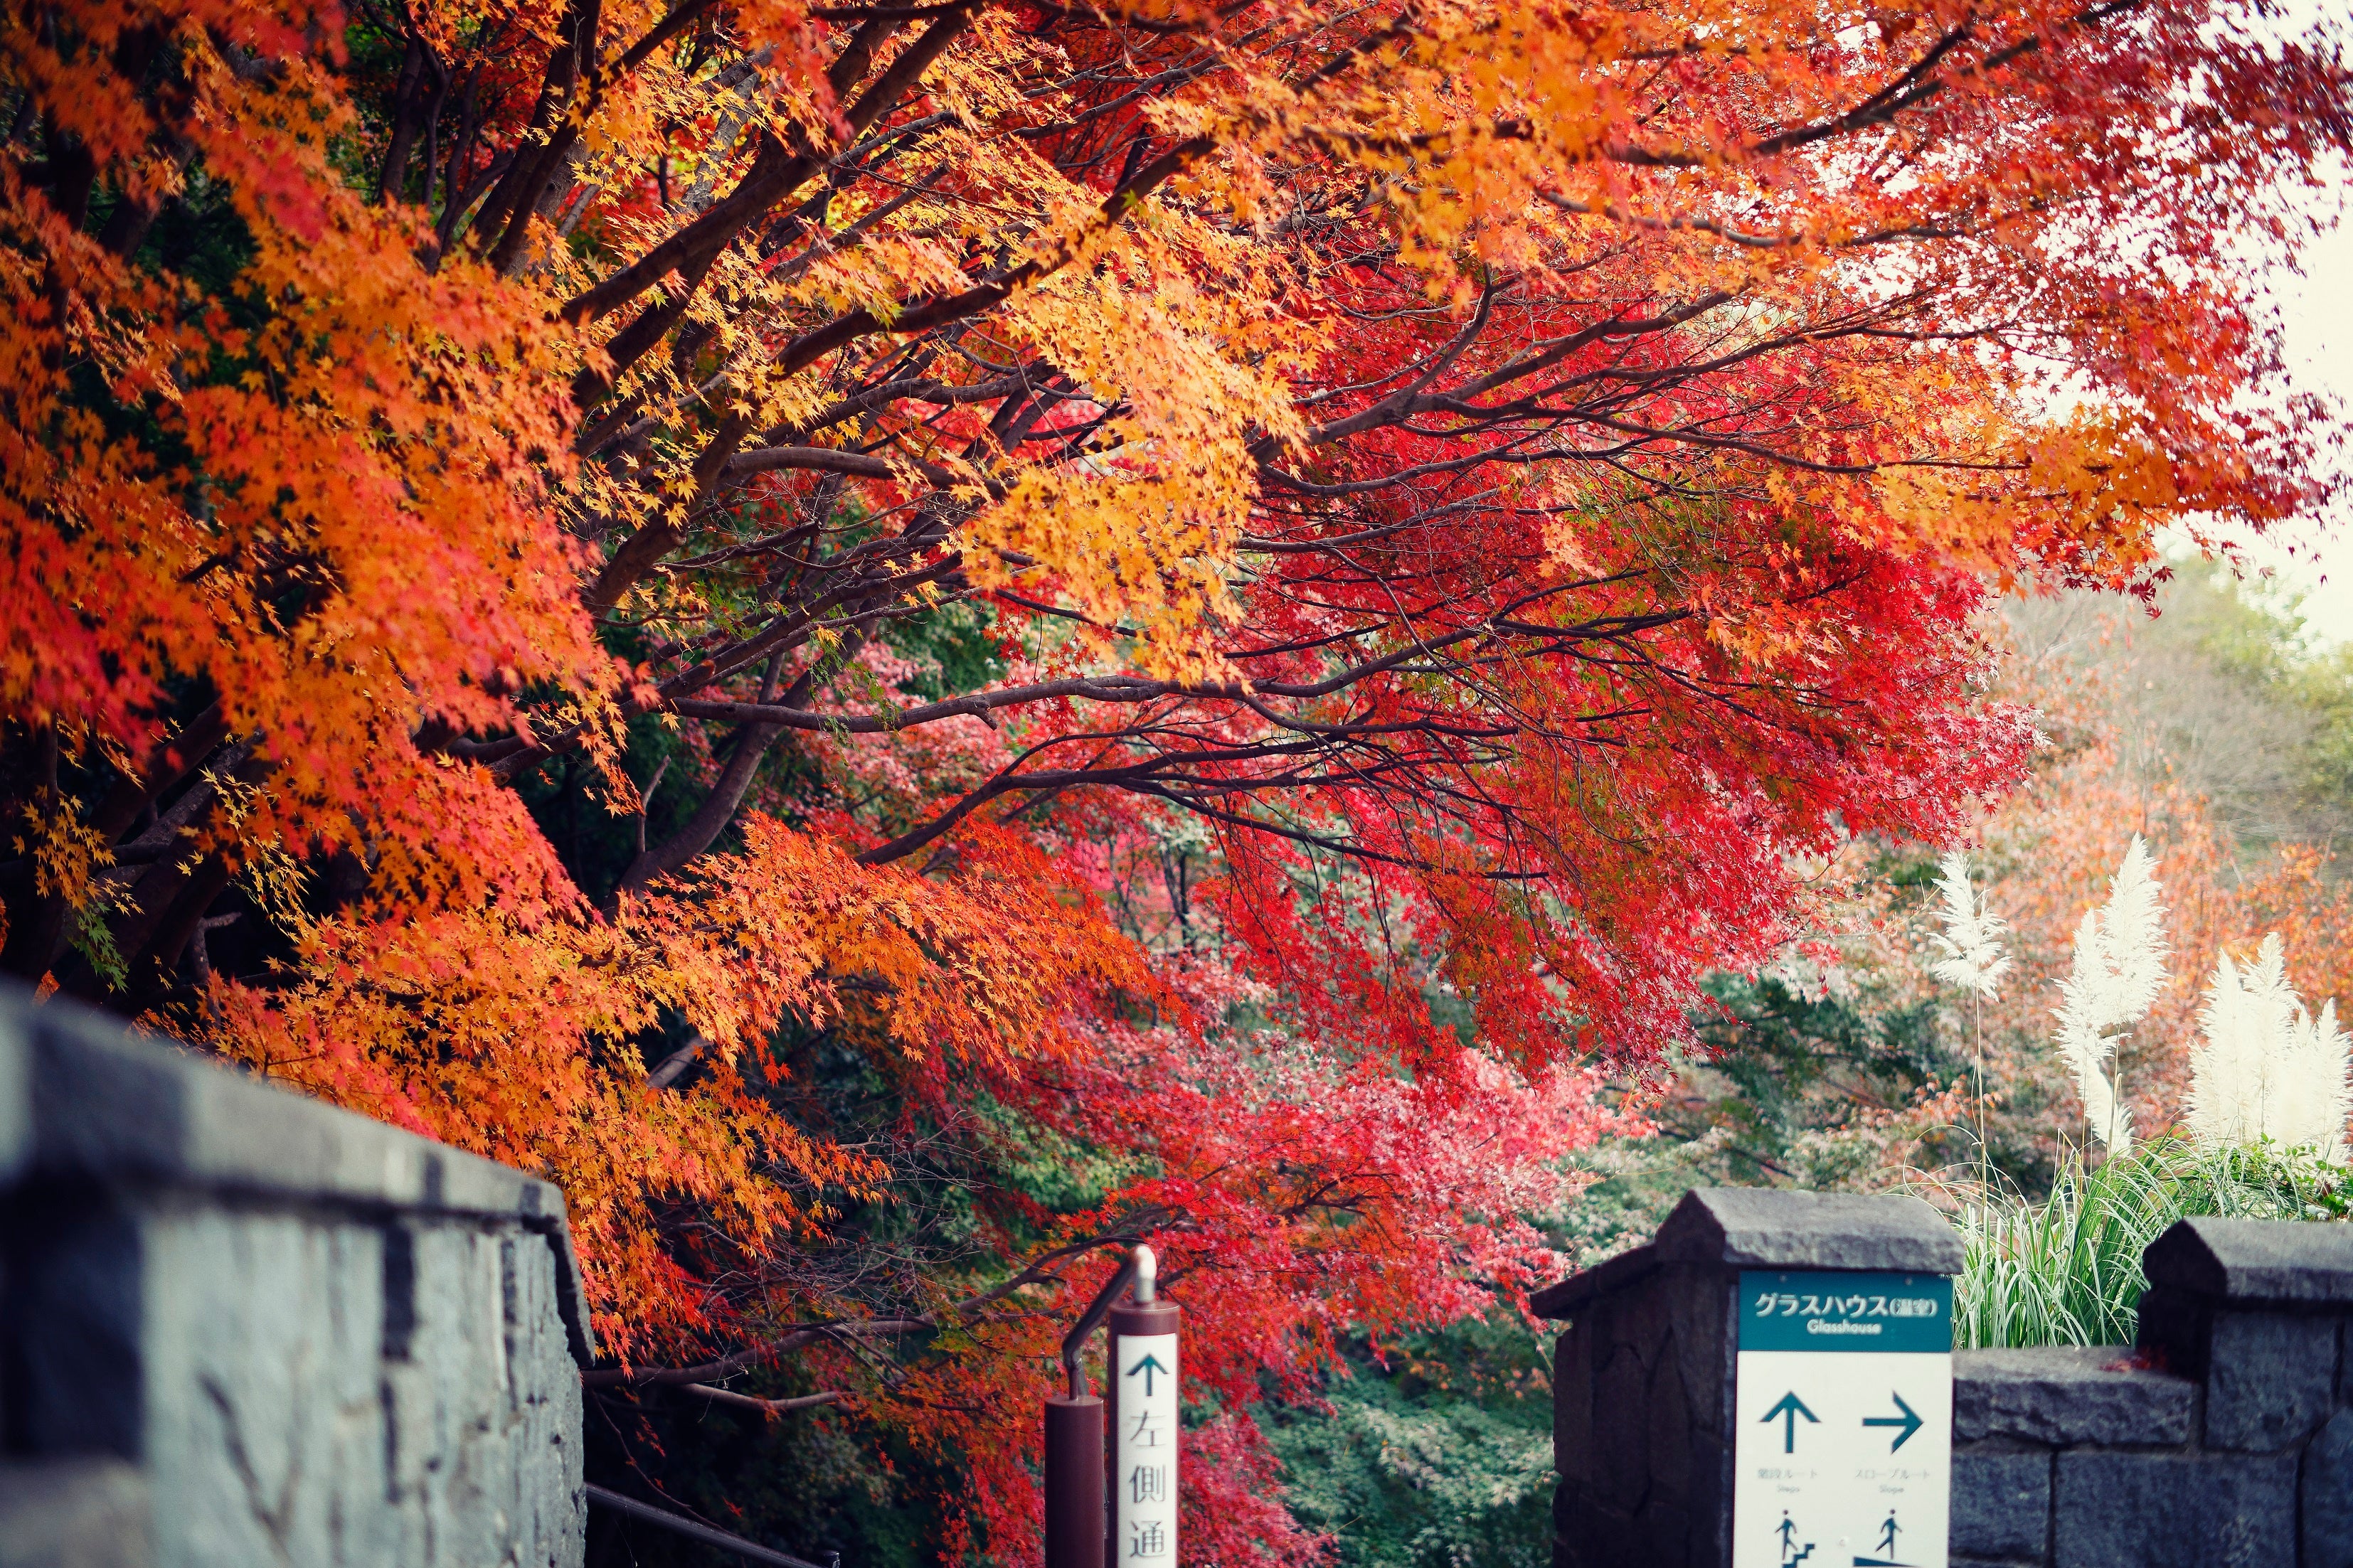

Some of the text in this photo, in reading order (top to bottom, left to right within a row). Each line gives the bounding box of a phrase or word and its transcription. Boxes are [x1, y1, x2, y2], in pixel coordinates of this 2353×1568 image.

[1807, 1320, 1882, 1335] Glasshouse
[1130, 1411, 1167, 1557] 左側通
